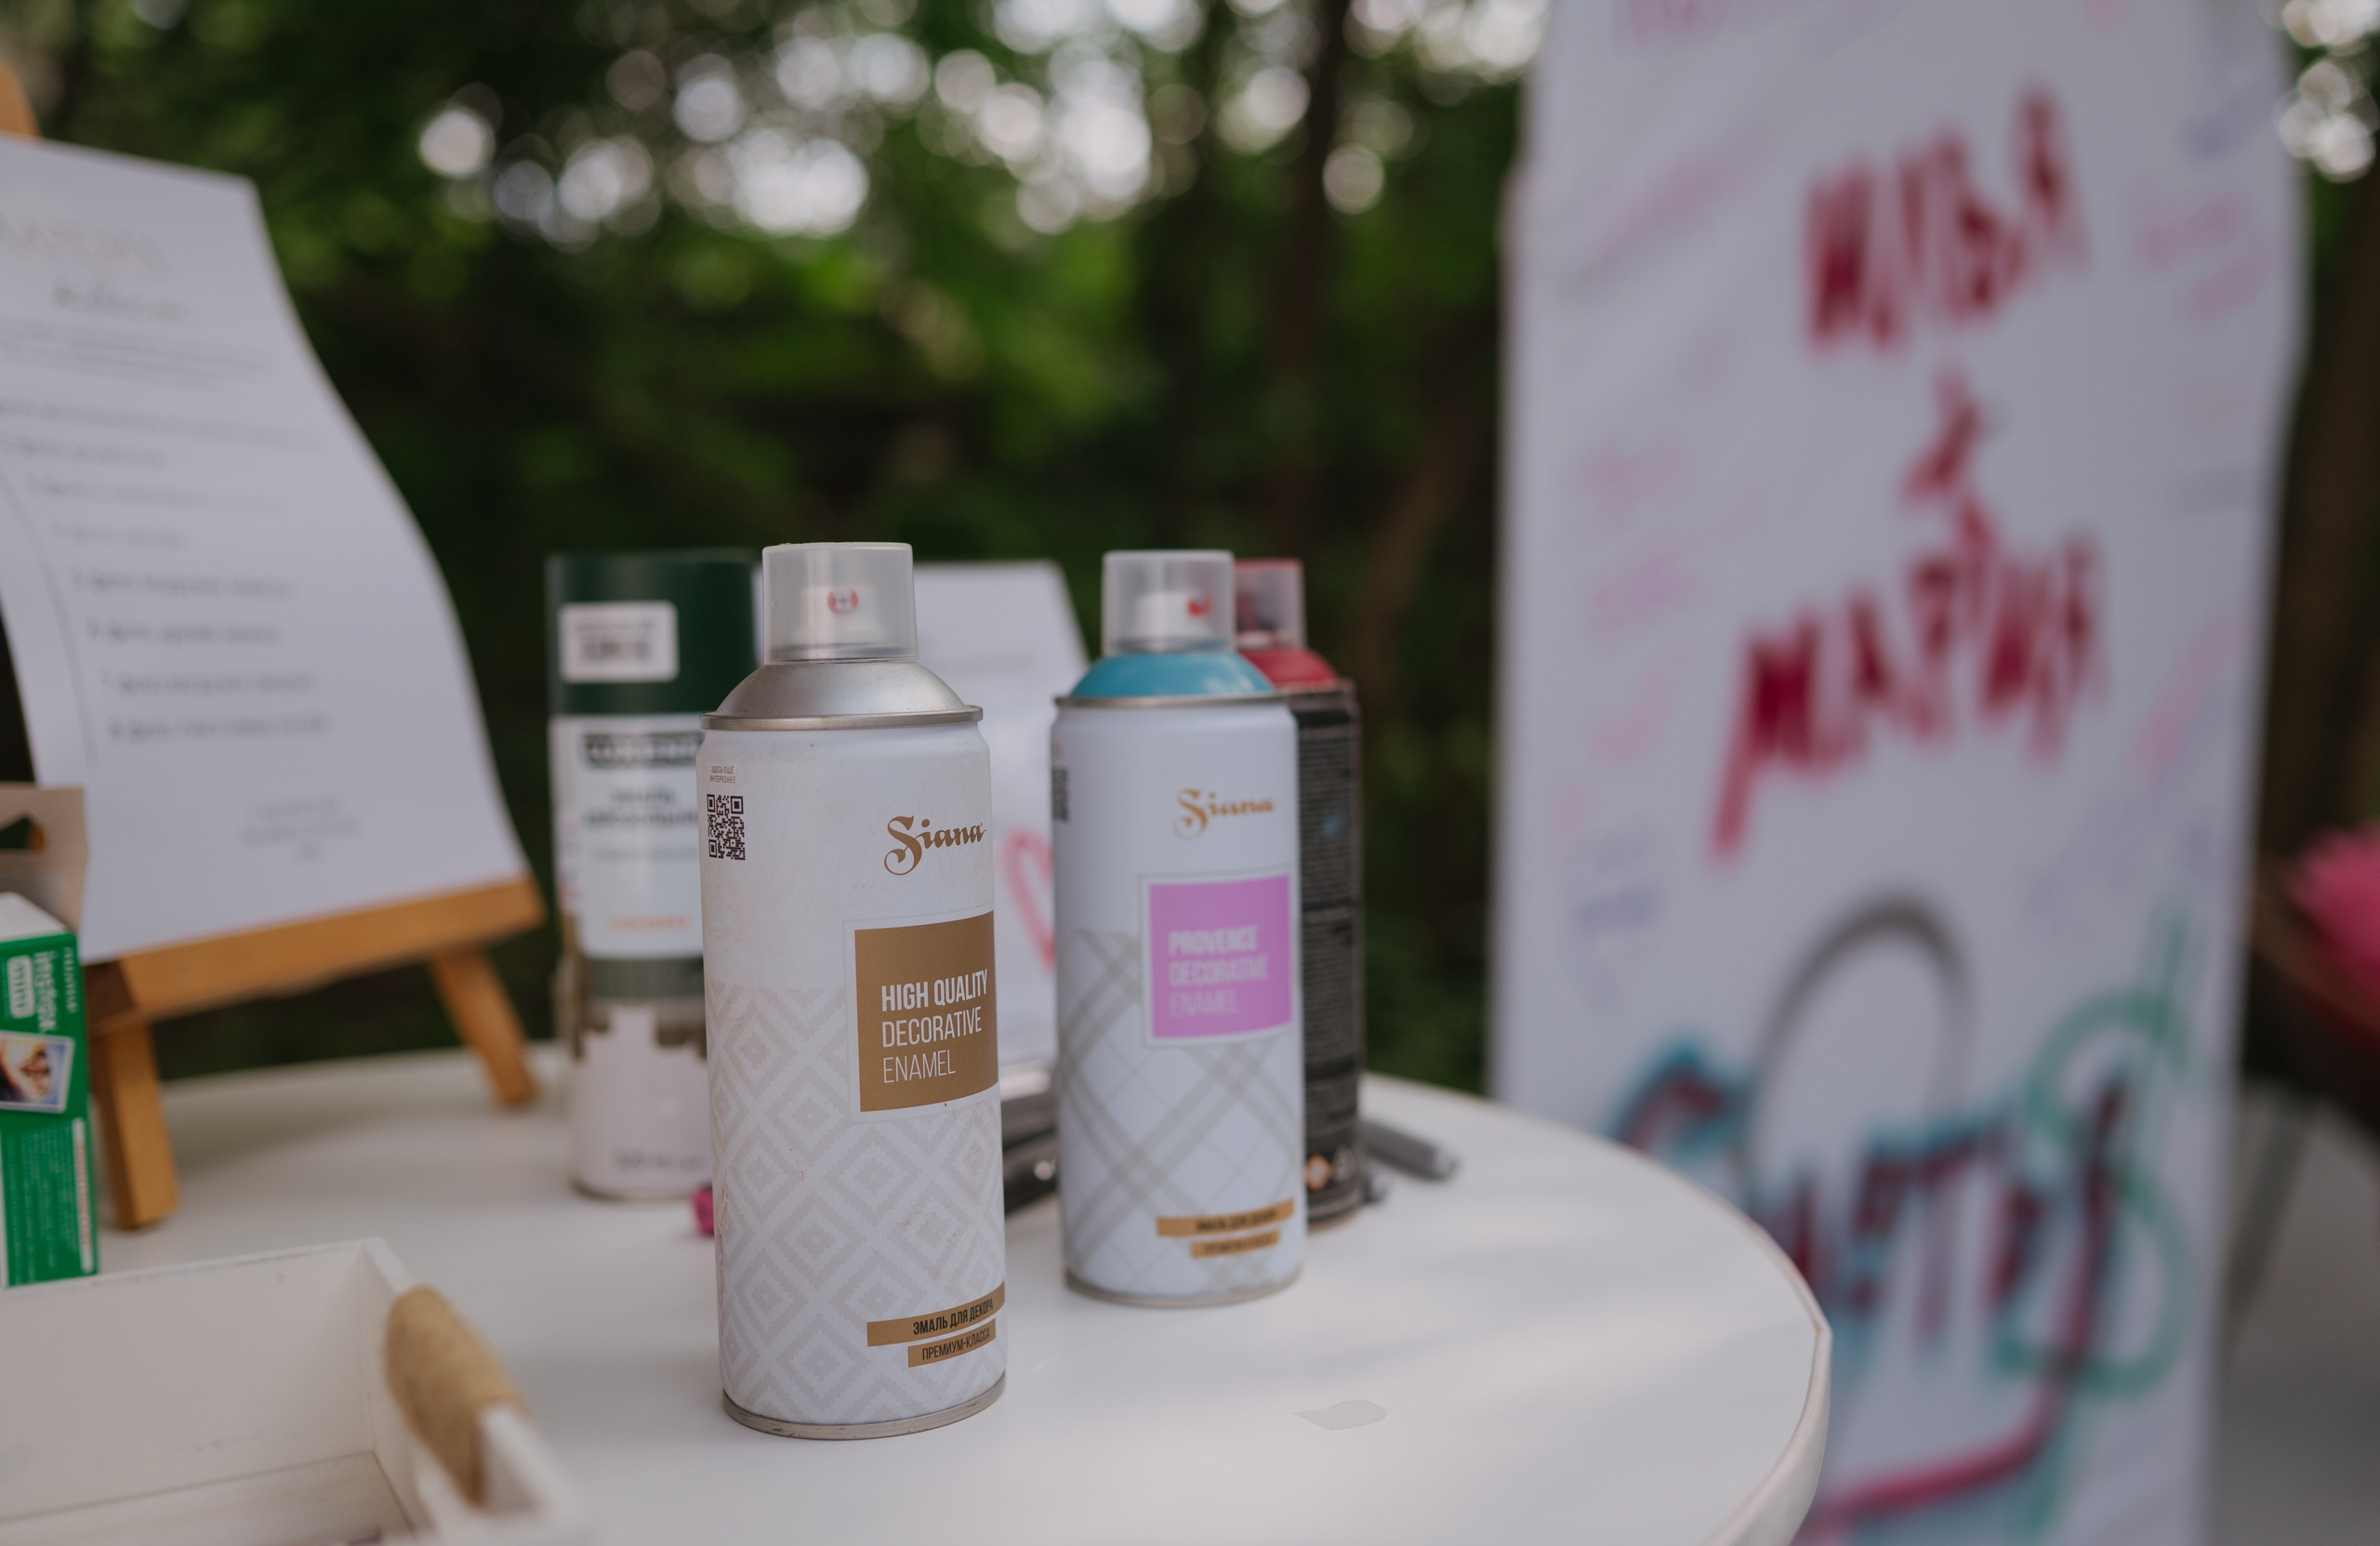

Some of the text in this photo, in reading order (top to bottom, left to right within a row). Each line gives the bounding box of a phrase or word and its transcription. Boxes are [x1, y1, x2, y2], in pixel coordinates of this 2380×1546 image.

[1172, 787, 1276, 841] Siana
[884, 815, 987, 876] Siana
[881, 969, 987, 1011] HIGH QUALITY
[881, 1006, 982, 1048] DECORATIVE
[883, 1049, 956, 1083] ENAMEL
[913, 1298, 993, 1335] ЭМАЛЬ ДЛЯ ДЕКОРА
[922, 1328, 990, 1360] ПРЕМИУМ-КЛАССА
